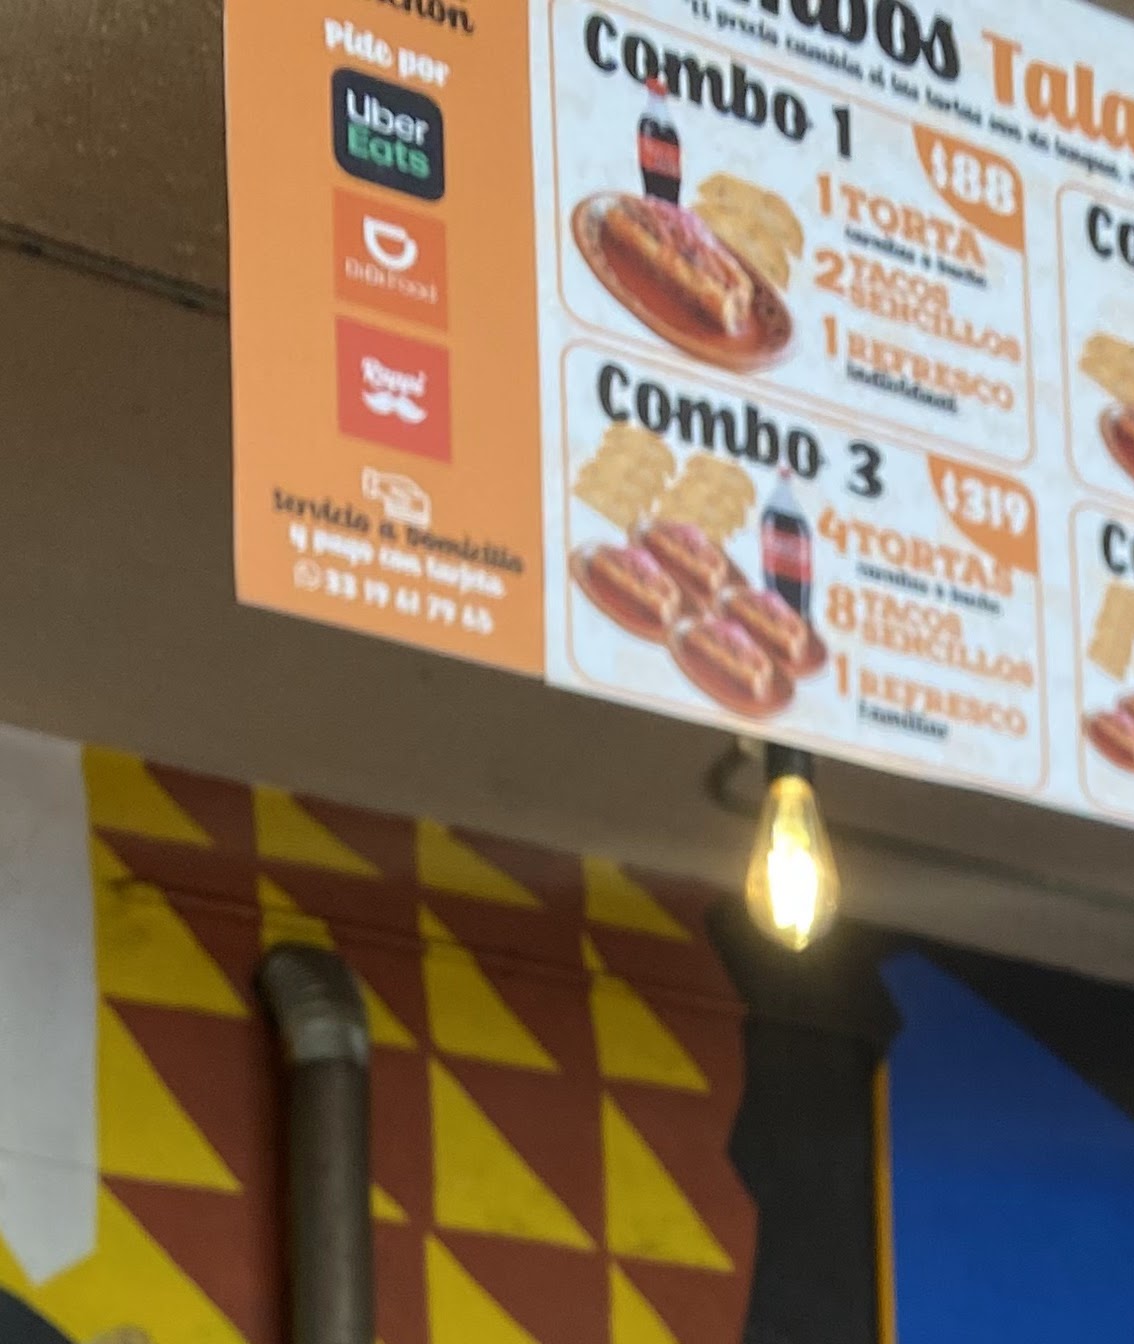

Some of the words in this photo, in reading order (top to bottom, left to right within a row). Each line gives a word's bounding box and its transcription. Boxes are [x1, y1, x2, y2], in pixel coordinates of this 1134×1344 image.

[346, 87, 430, 146] Uber
[584, 11, 813, 141] Combo
[833, 104, 852, 158] 1
[347, 122, 431, 179] Eats
[839, 182, 987, 268] TORTA
[814, 249, 846, 296] 2
[597, 362, 827, 481] Combo
[846, 439, 884, 499] 3
